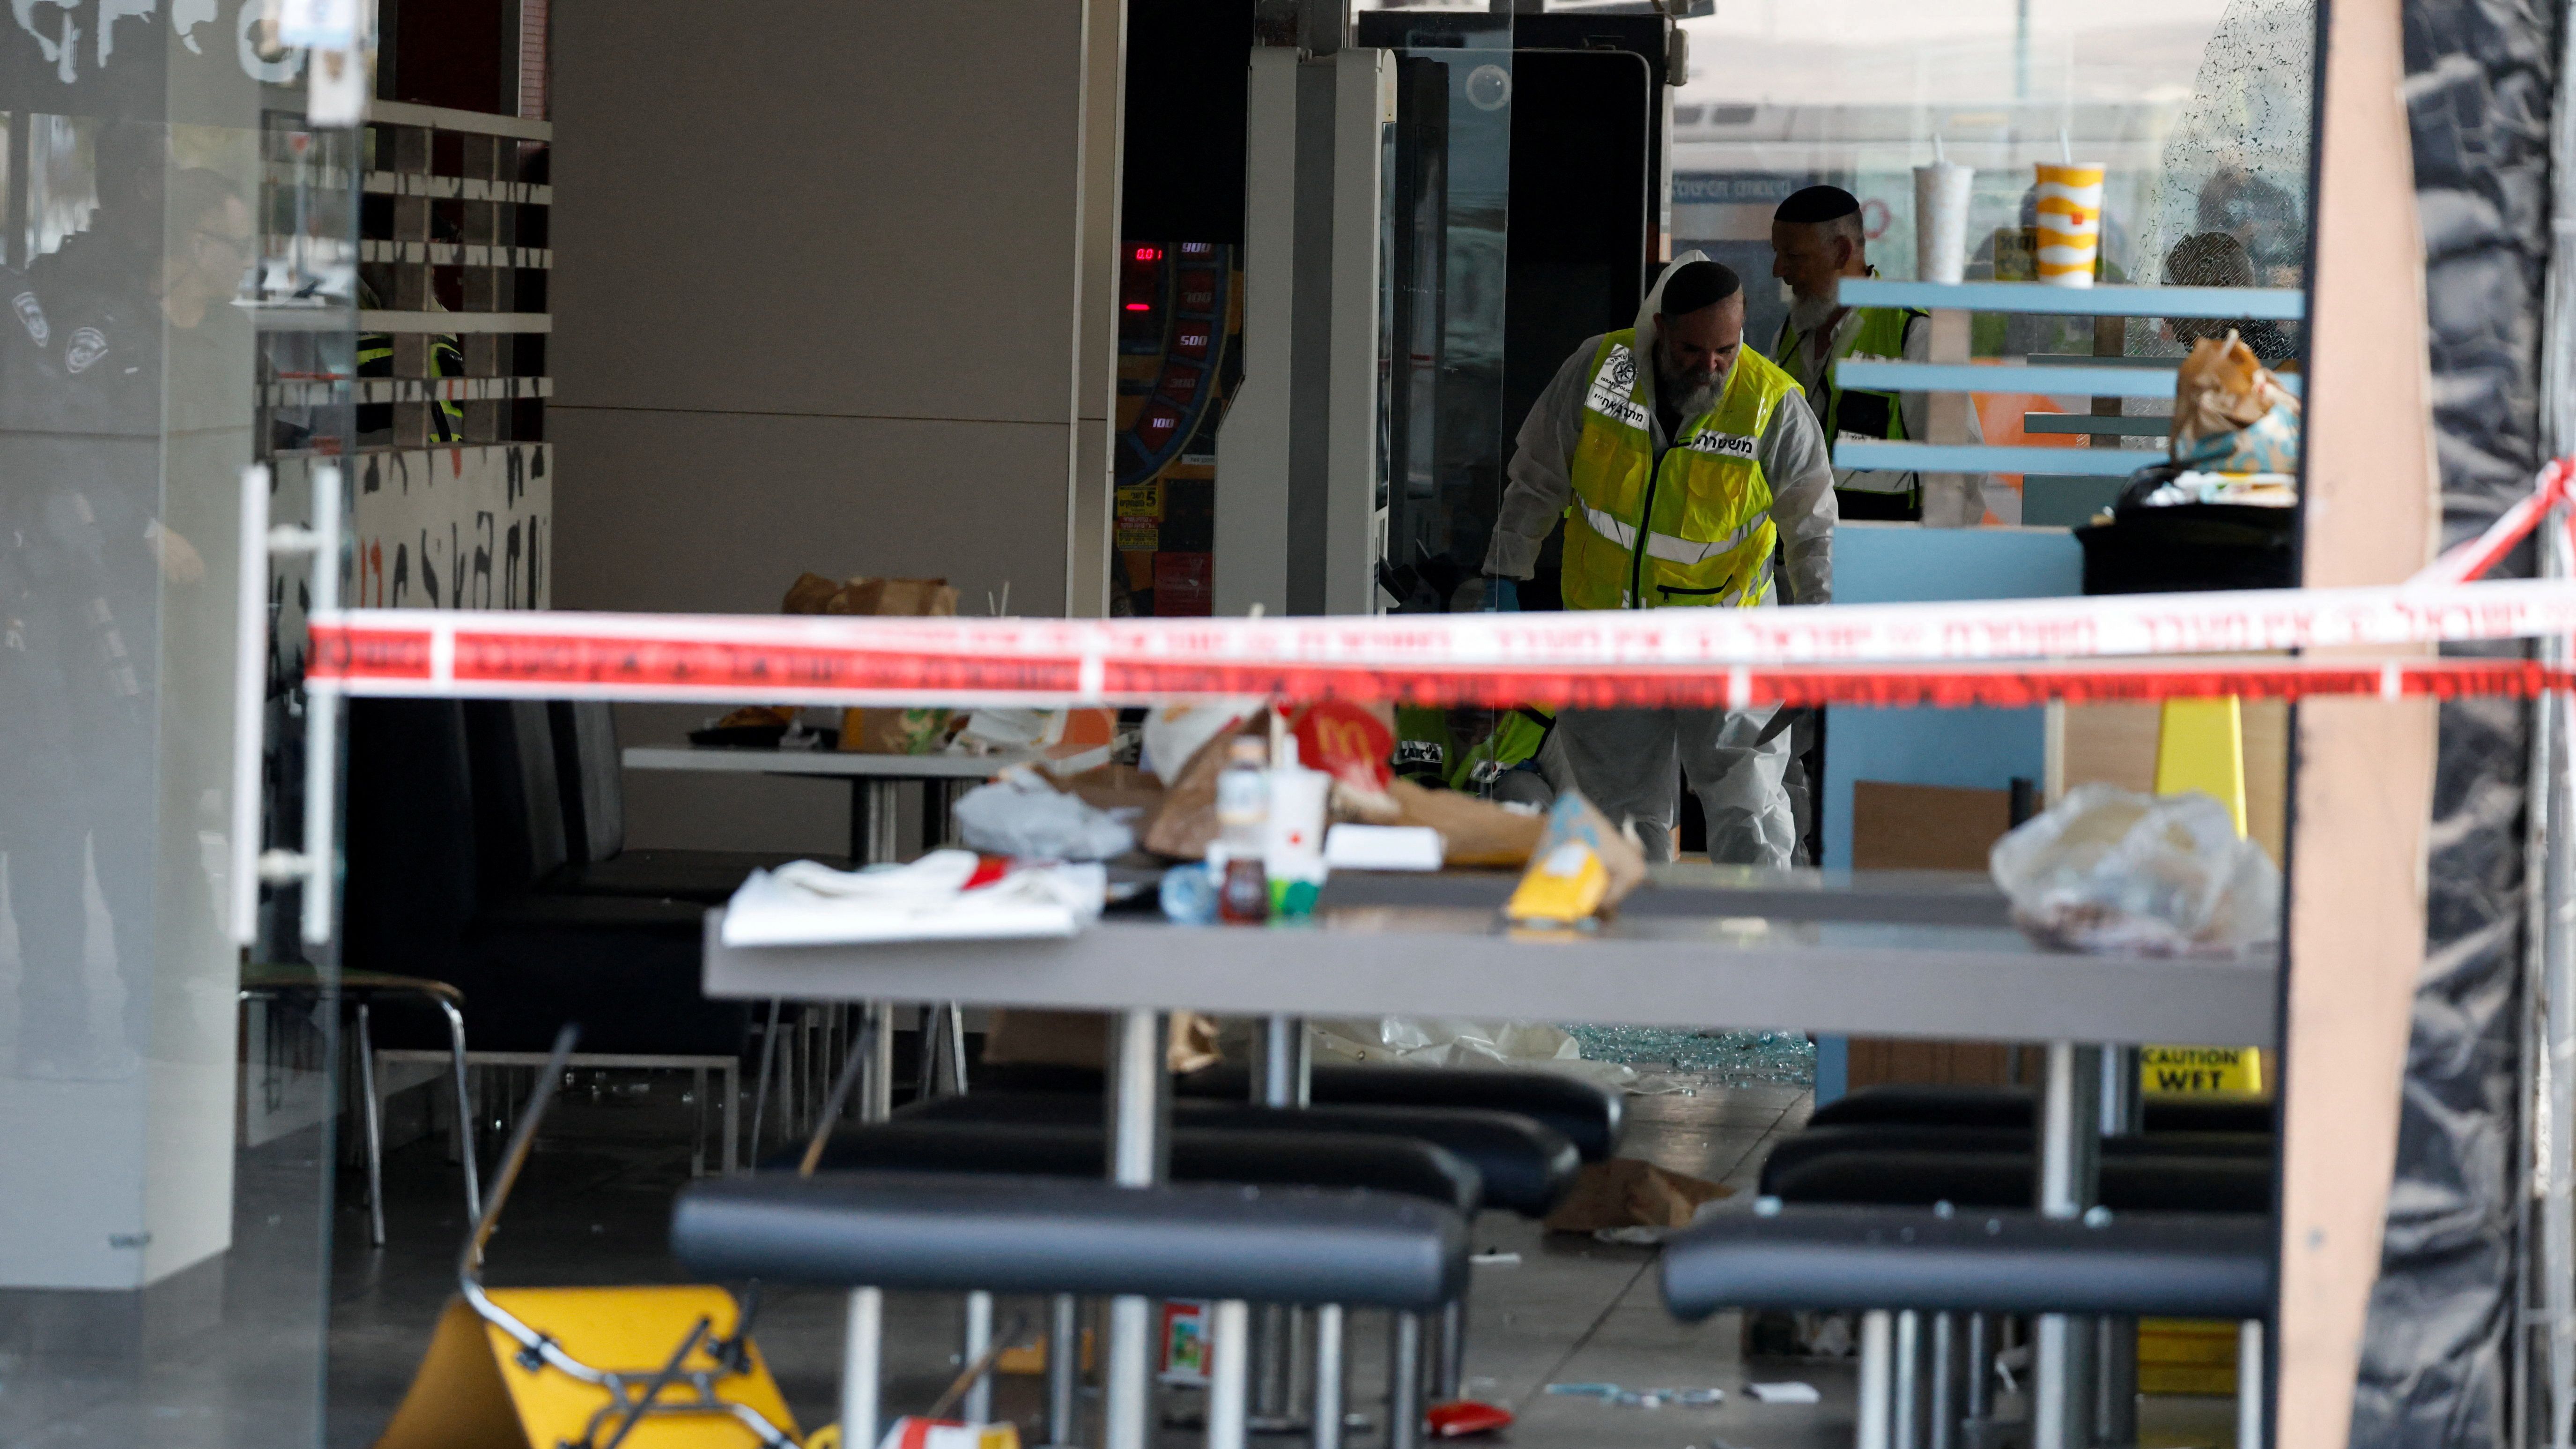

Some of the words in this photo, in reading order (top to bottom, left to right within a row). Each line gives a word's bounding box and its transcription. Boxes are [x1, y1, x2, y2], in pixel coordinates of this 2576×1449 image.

[1180, 335, 1208, 347] 500
[1600, 377, 1617, 387] ISRAEL
[1617, 384, 1631, 394] POLIC
[1153, 417, 1175, 428] 100
[1697, 434, 1752, 453] משטרה
[1146, 491, 1156, 506] 5
[2142, 1048, 2239, 1066] CAUTION
[2158, 1070, 2224, 1091] WET
